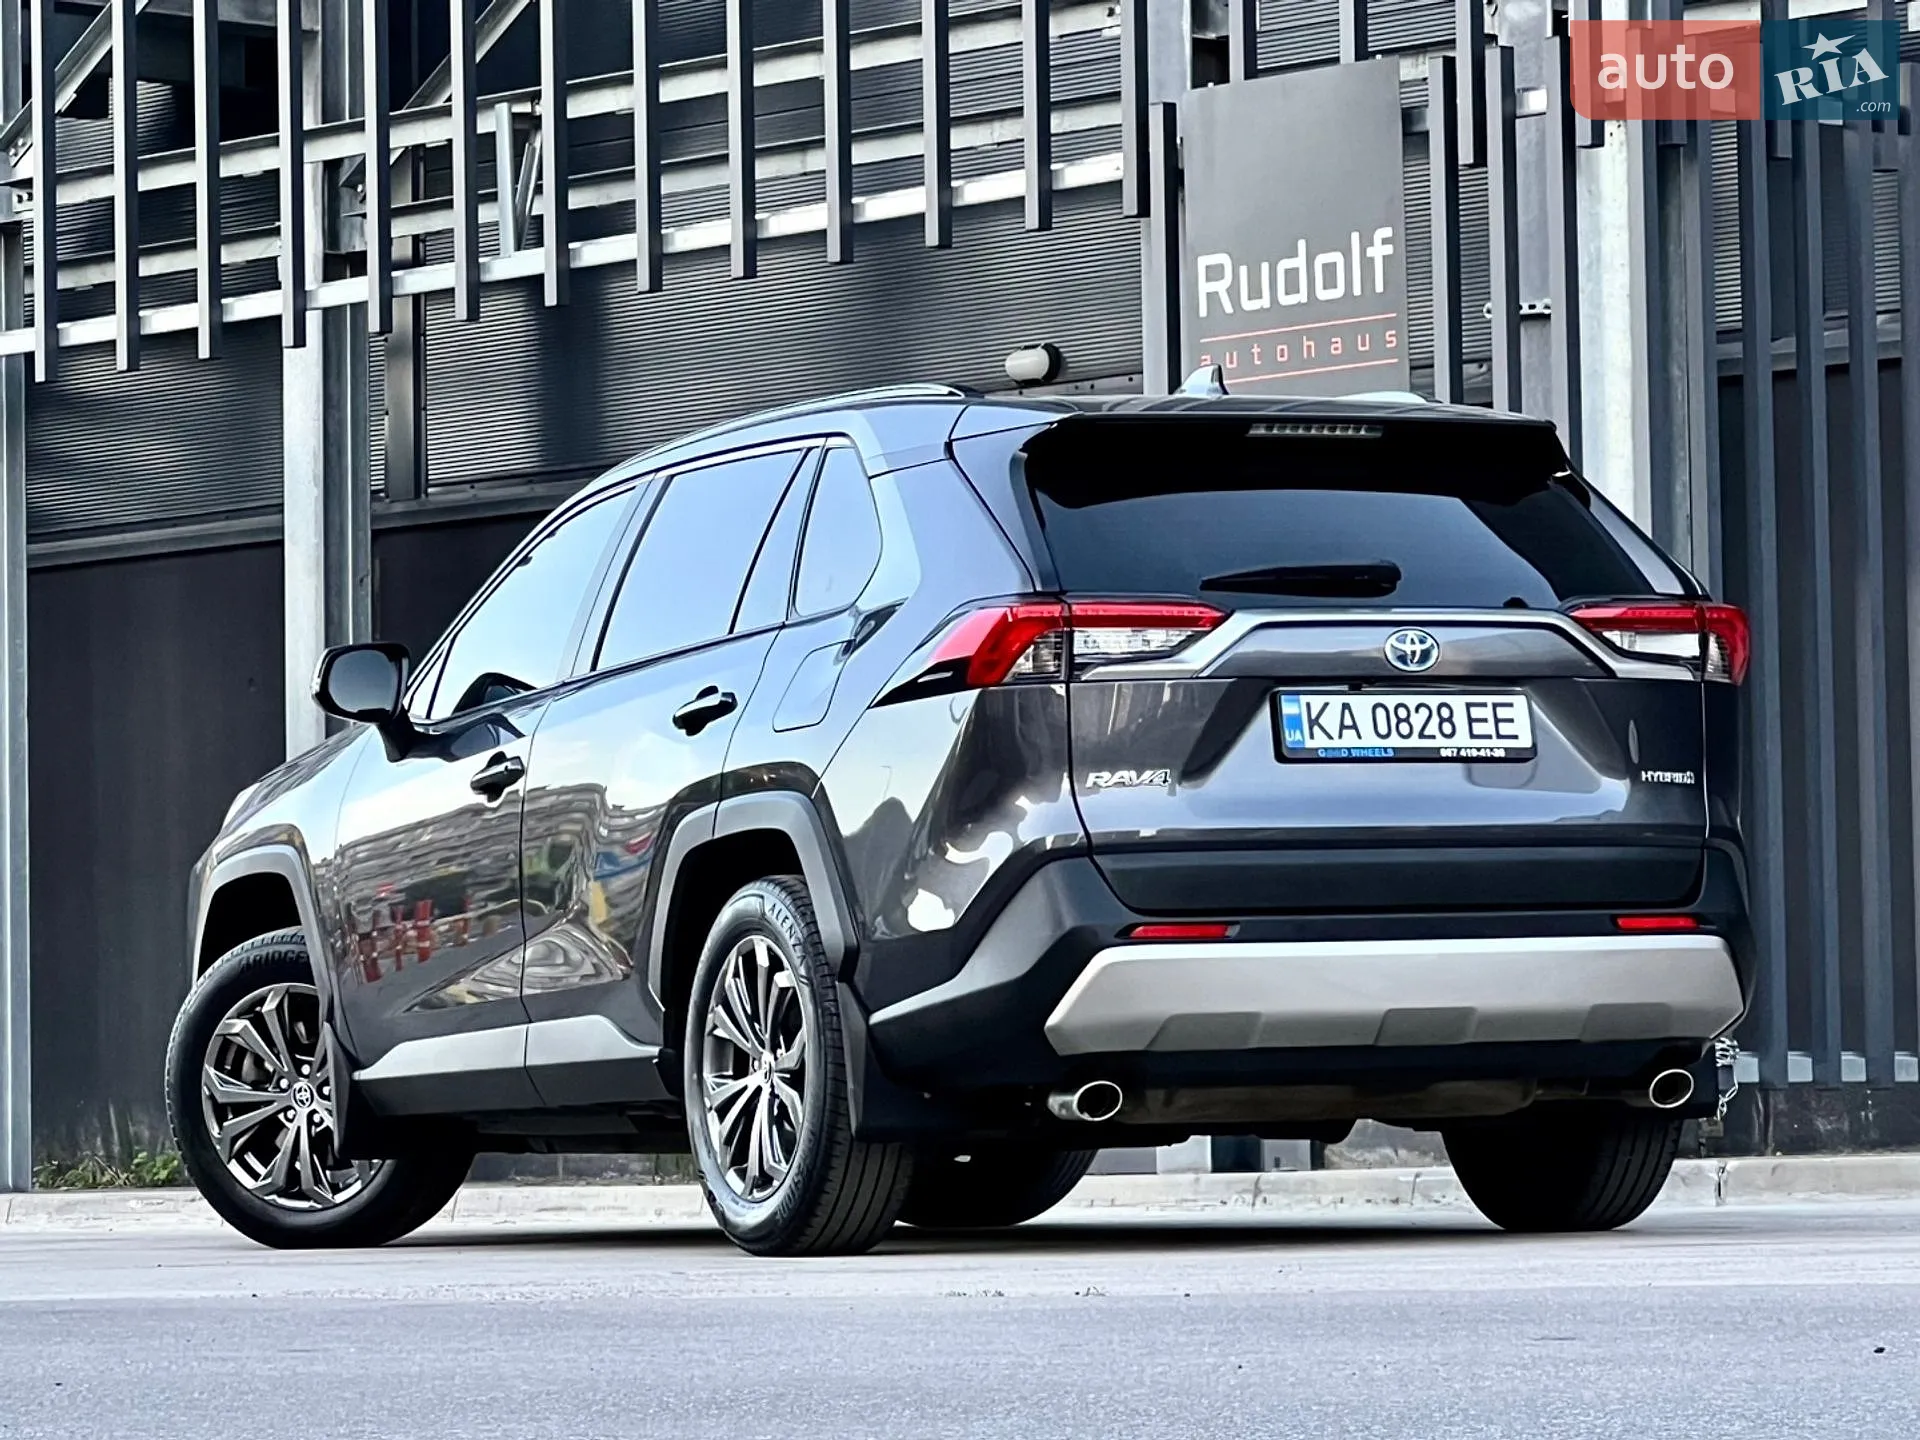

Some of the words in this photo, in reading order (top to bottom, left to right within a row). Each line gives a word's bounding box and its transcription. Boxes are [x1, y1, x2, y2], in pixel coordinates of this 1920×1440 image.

[1197, 226, 1395, 318] Rudolf
[1200, 329, 1398, 369] autohaus
[1285, 728, 1304, 742] UA
[1305, 701, 1363, 741] KA
[1371, 702, 1457, 741] 0828
[1465, 701, 1520, 741] EE
[1085, 768, 1172, 789] RAV4
[1641, 770, 1695, 785] HYBRID
